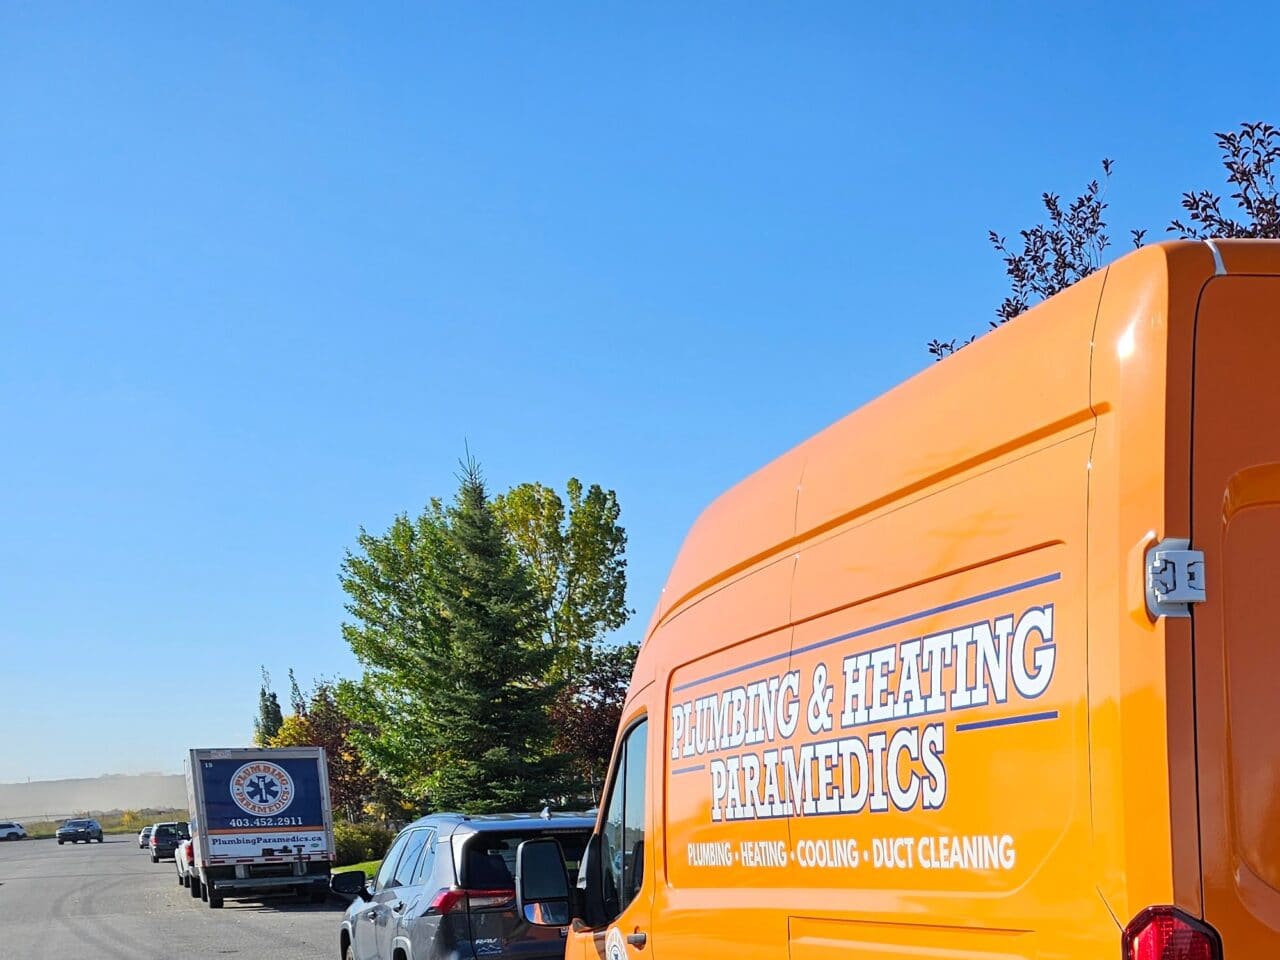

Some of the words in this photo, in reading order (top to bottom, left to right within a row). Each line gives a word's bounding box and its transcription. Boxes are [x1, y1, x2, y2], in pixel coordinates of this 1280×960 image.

[671, 670, 801, 760] PLUMBING
[807, 663, 834, 735] &
[840, 603, 1057, 728] HEATING
[235, 764, 288, 786] PLUMBING
[710, 723, 947, 822] PARAMEDICS
[236, 790, 289, 814] PARAMEDICS
[229, 817, 303, 827] 403.452.2911
[212, 835, 322, 845] PlumbingParamedics.ca
[688, 841, 732, 867] PLUMBING
[741, 841, 787, 867] HEATING
[797, 840, 859, 867] COOLING
[873, 838, 915, 868] DUCT
[918, 835, 1015, 870] CLEANING
